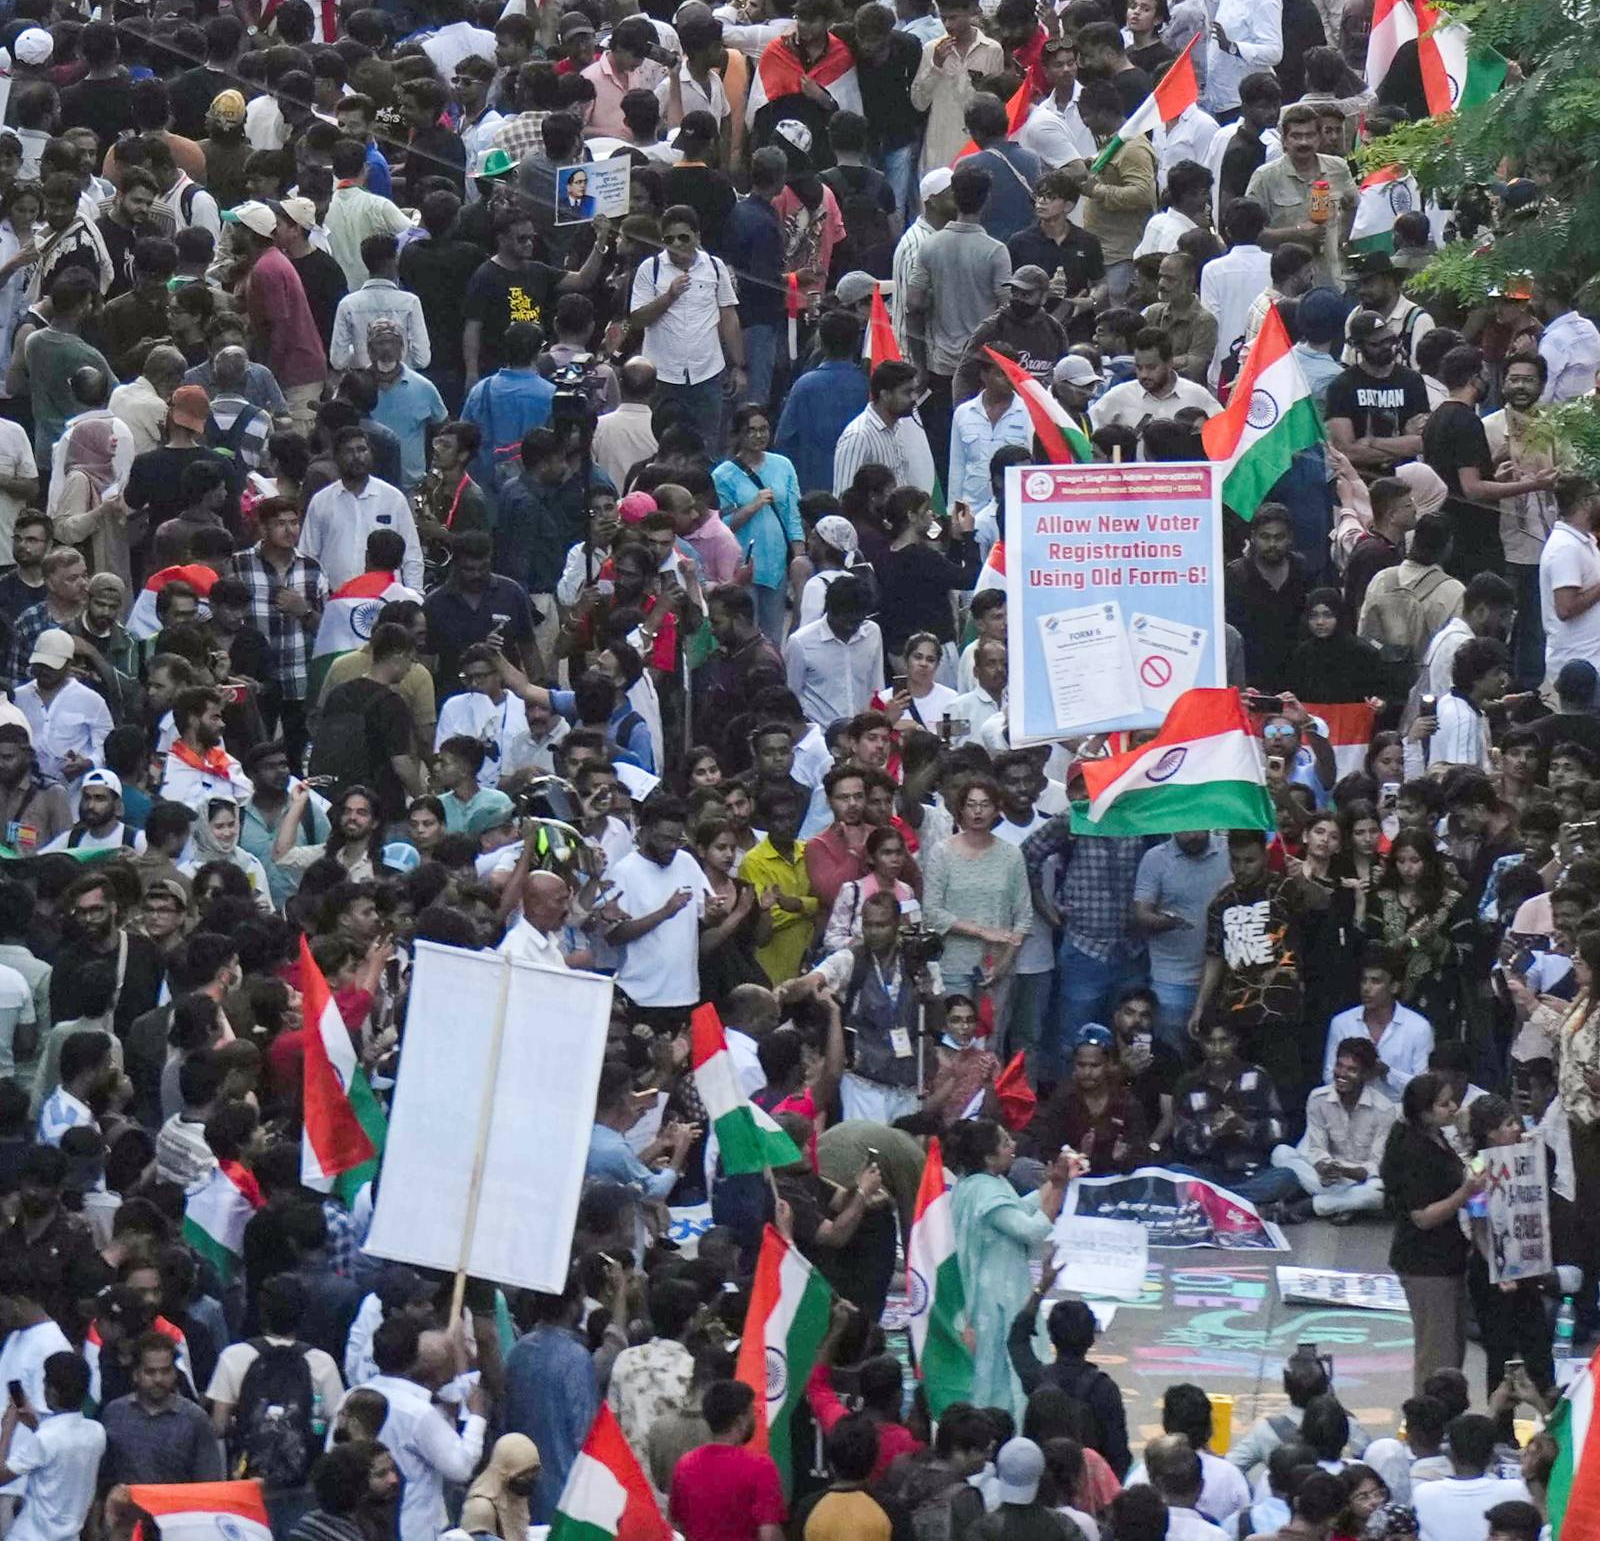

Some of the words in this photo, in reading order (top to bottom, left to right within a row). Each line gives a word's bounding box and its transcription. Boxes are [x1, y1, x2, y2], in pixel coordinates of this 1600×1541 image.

[1357, 389, 1404, 408] BATMAN
[1035, 516, 1091, 534] Allow
[1098, 515, 1140, 532] New
[1146, 514, 1200, 532] Voter
[1049, 540, 1182, 563] Registrations
[1029, 569, 1085, 589] Using
[1092, 568, 1122, 586] Old
[1129, 566, 1207, 585] Form-6!
[1222, 900, 1270, 924] RIDE
[1224, 923, 1270, 943] THE
[1223, 939, 1275, 970] WAVE
